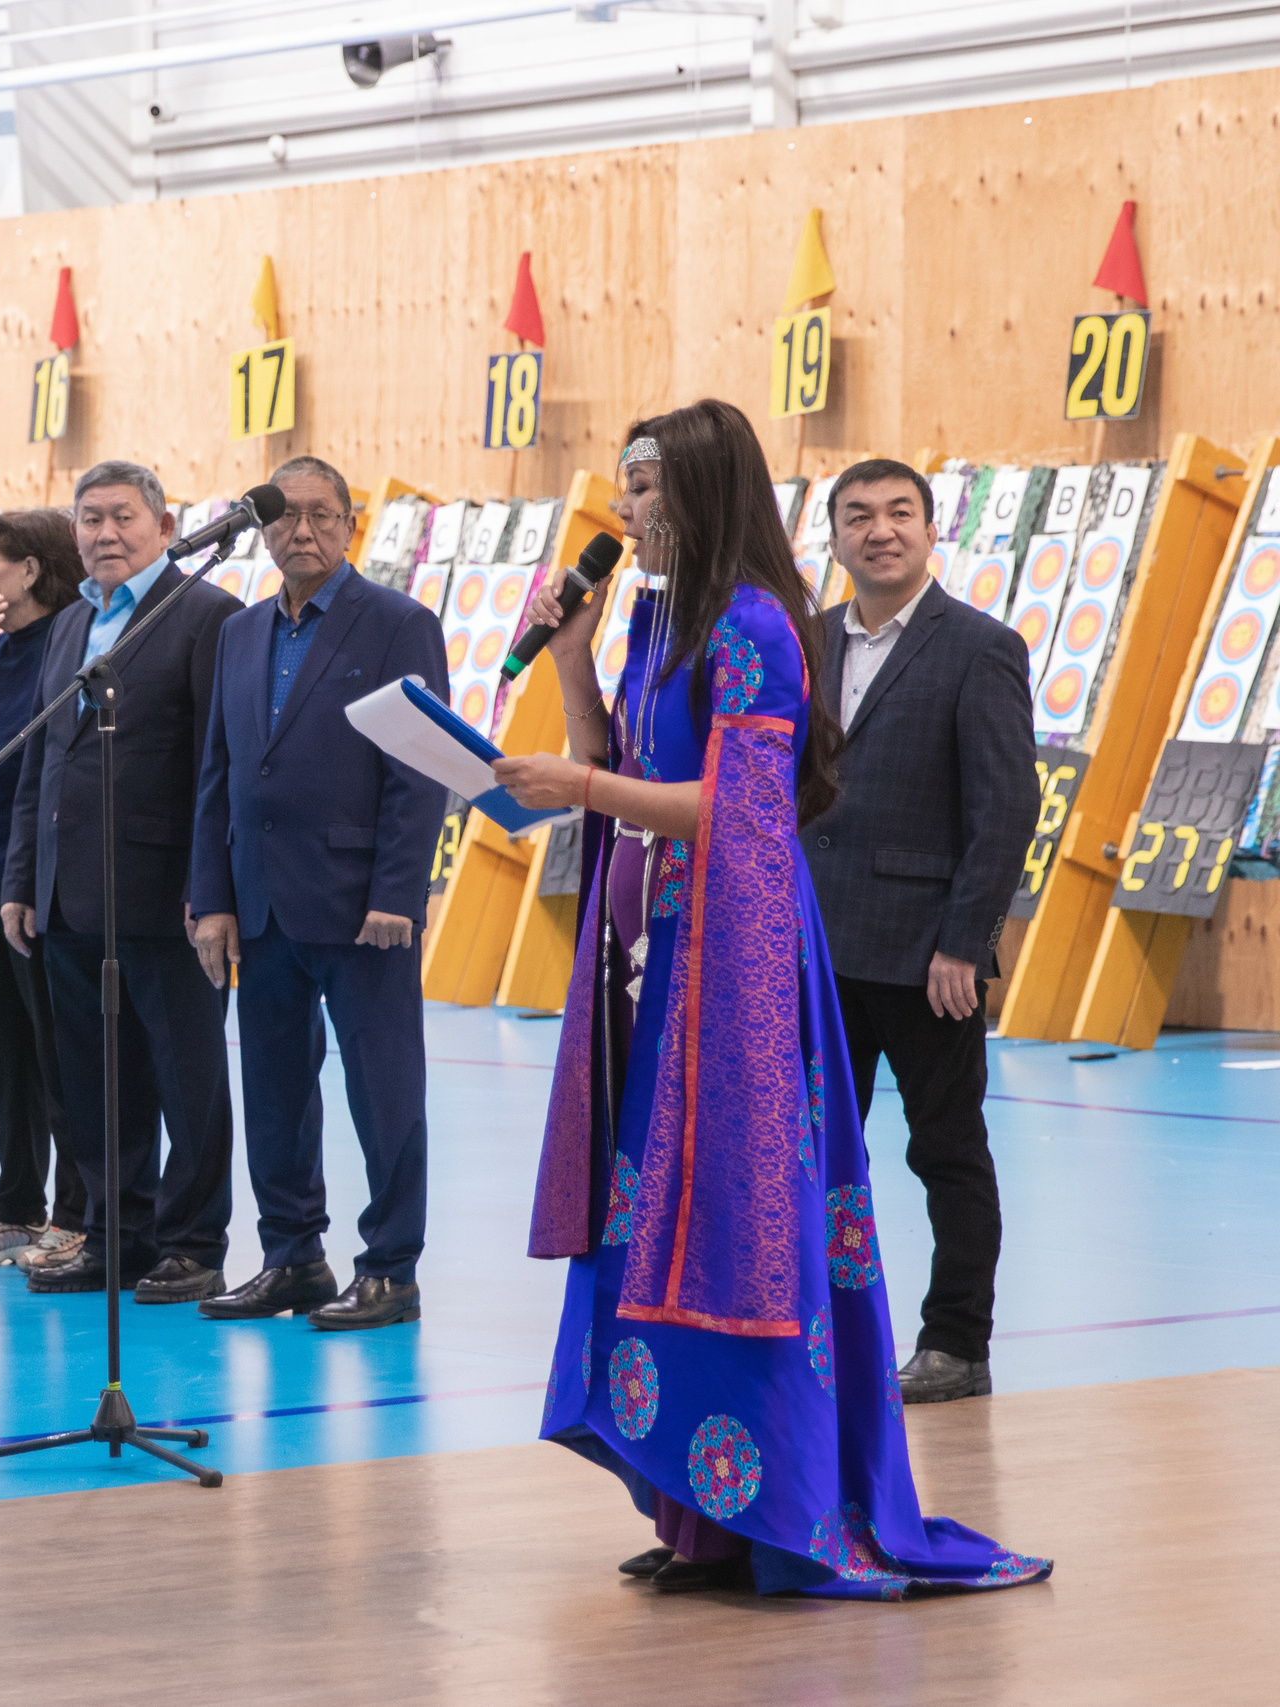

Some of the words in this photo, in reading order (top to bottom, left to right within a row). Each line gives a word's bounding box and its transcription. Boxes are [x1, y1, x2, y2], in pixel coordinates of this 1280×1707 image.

[33, 353, 68, 440] 16
[238, 346, 284, 434] 17
[489, 353, 538, 448] 18
[782, 315, 821, 413] 19
[1066, 312, 1144, 420] 20
[381, 521, 399, 549] A
[435, 522, 450, 548] C
[476, 527, 492, 560] B
[522, 528, 538, 553] D
[996, 491, 1016, 520] C
[1057, 486, 1075, 516] B
[1114, 487, 1134, 518] D
[1121, 822, 1233, 893] 271
